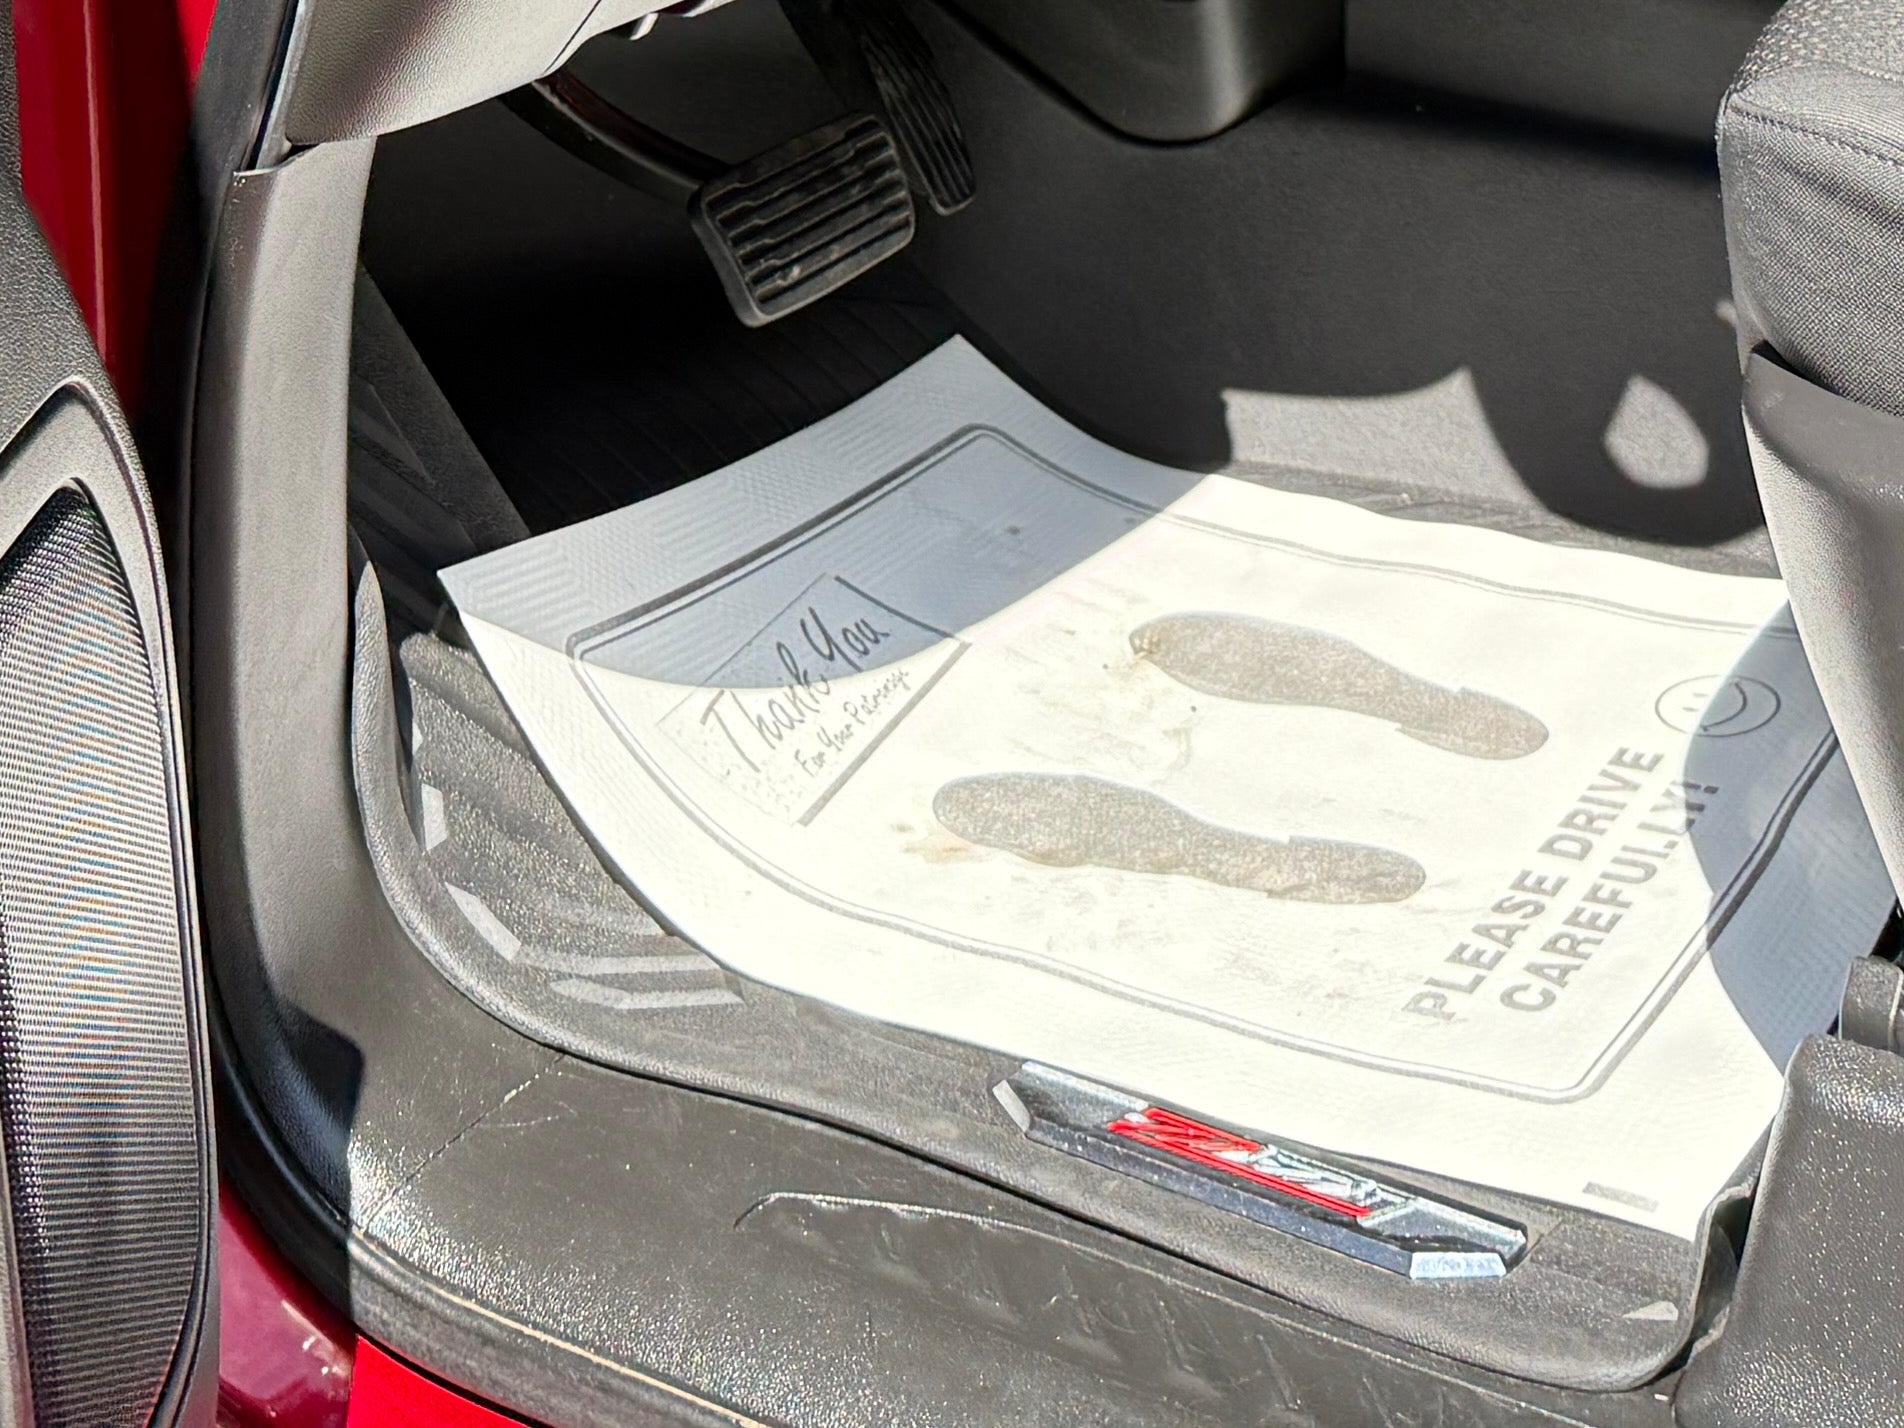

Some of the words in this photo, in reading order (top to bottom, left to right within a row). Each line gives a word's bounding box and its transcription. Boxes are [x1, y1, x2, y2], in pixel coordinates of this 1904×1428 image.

[699, 641, 831, 773] Thank
[800, 606, 891, 673] You
[1400, 869, 1569, 1022] PLEASE
[1537, 747, 1665, 862] DRIVE
[1499, 779, 1720, 1013] CAREFULLY!
